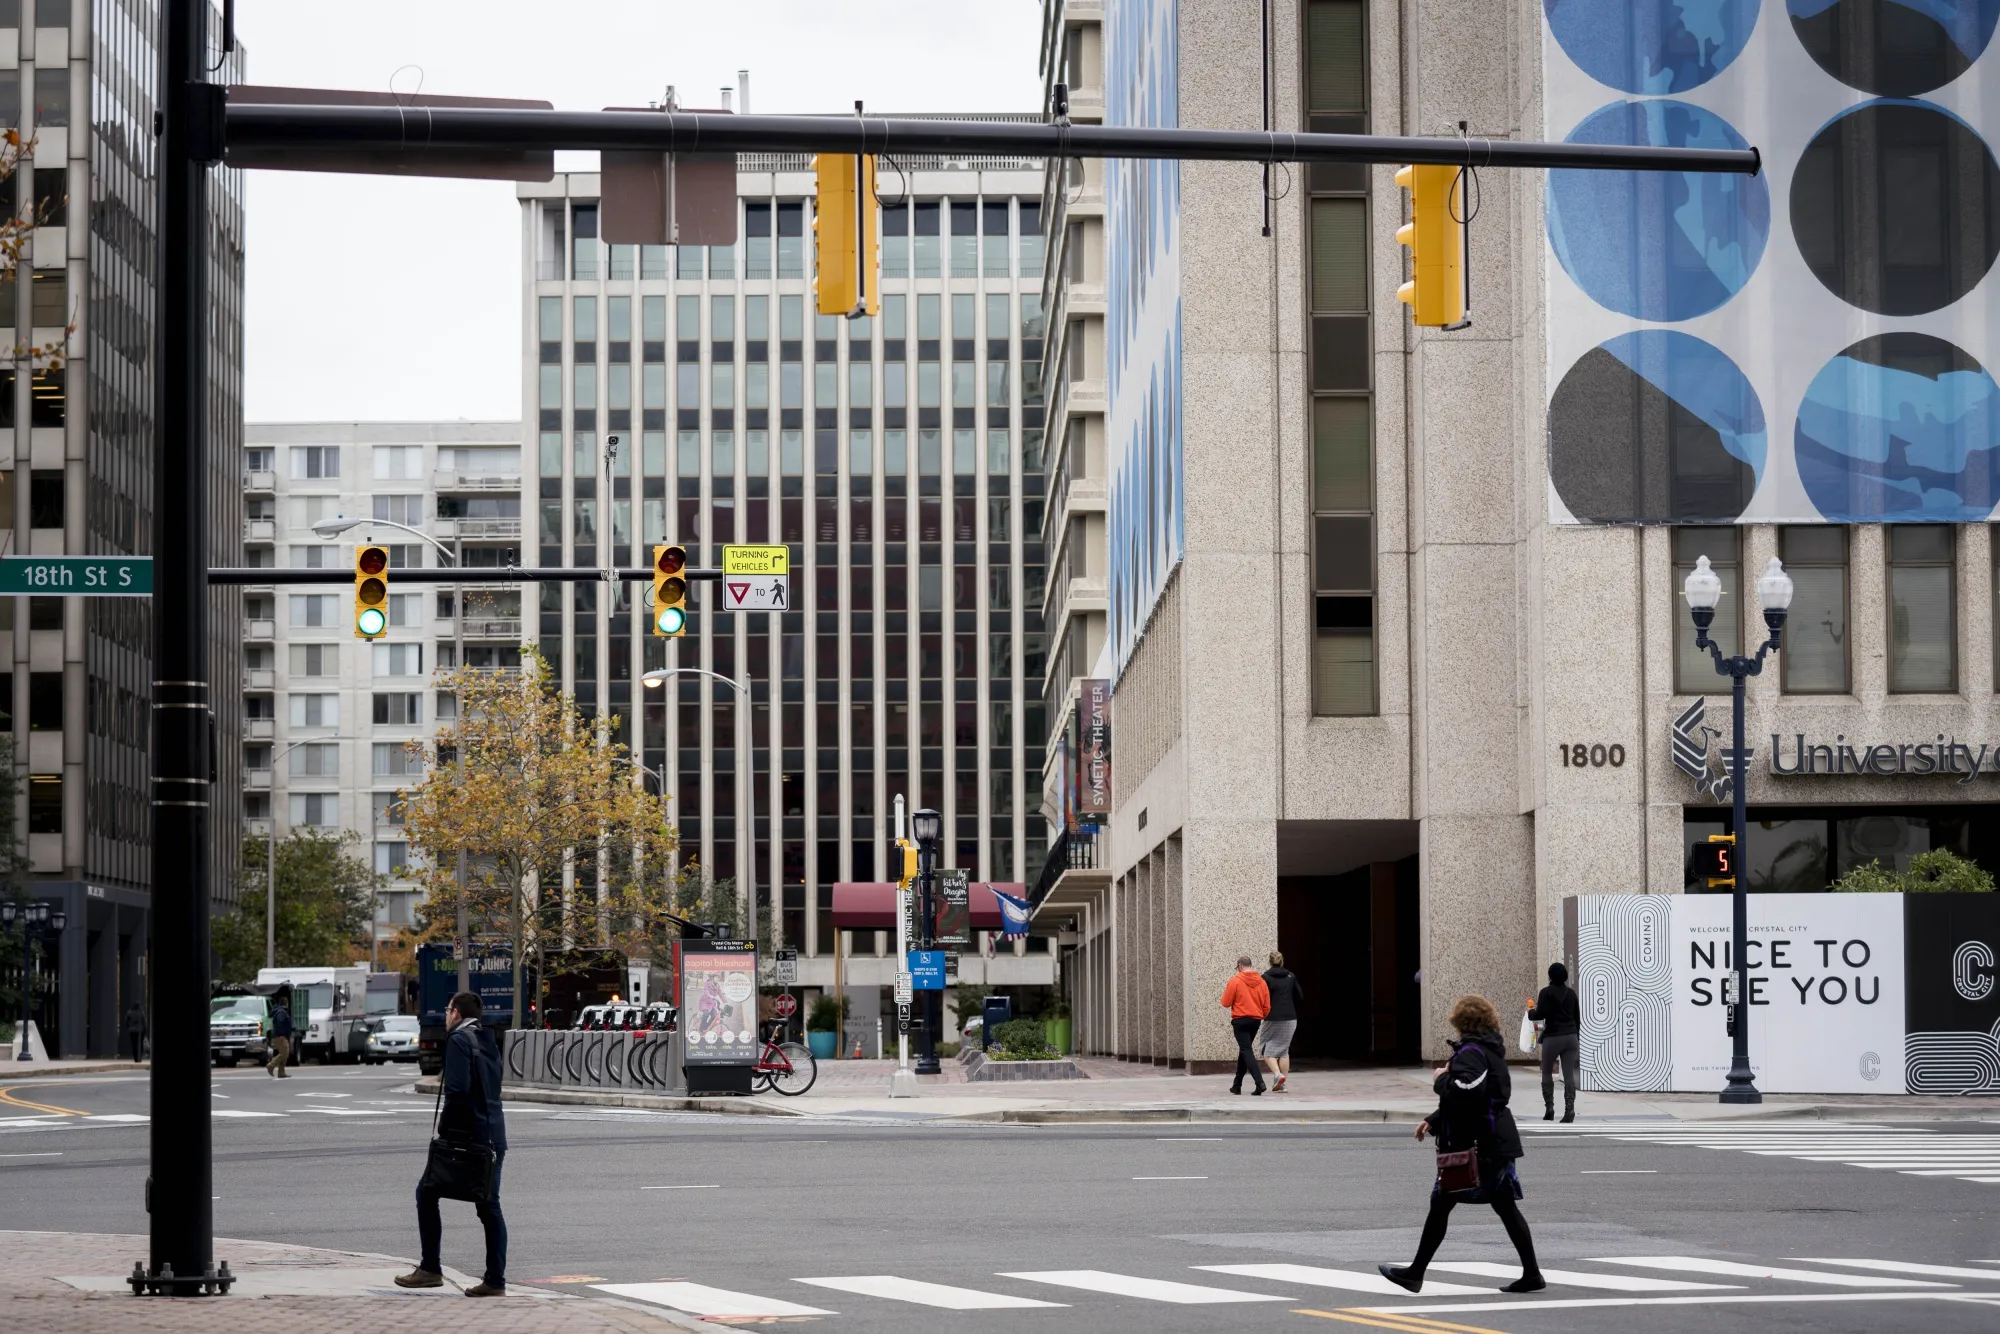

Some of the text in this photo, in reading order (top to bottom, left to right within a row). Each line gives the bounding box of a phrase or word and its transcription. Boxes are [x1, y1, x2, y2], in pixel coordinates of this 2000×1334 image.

[731, 550, 768, 558] TURNING
[732, 562, 768, 570] VEHICLES
[24, 565, 132, 586] 18th St S
[755, 588, 766, 596] TO
[1092, 686, 1104, 806] SYNETIC THEATER
[1560, 743, 1626, 768] 1800
[1771, 734, 1988, 785] University
[1718, 850, 1728, 872] 5
[1643, 915, 1652, 964] COMING
[685, 959, 712, 968] capital
[1691, 939, 1870, 969] NICE TO
[1596, 979, 1606, 1014] GOOD
[1791, 976, 1880, 1005] YOU
[1957, 977, 1990, 997] CRYSTAL CITY
[1626, 1011, 1635, 1055] THINGS
